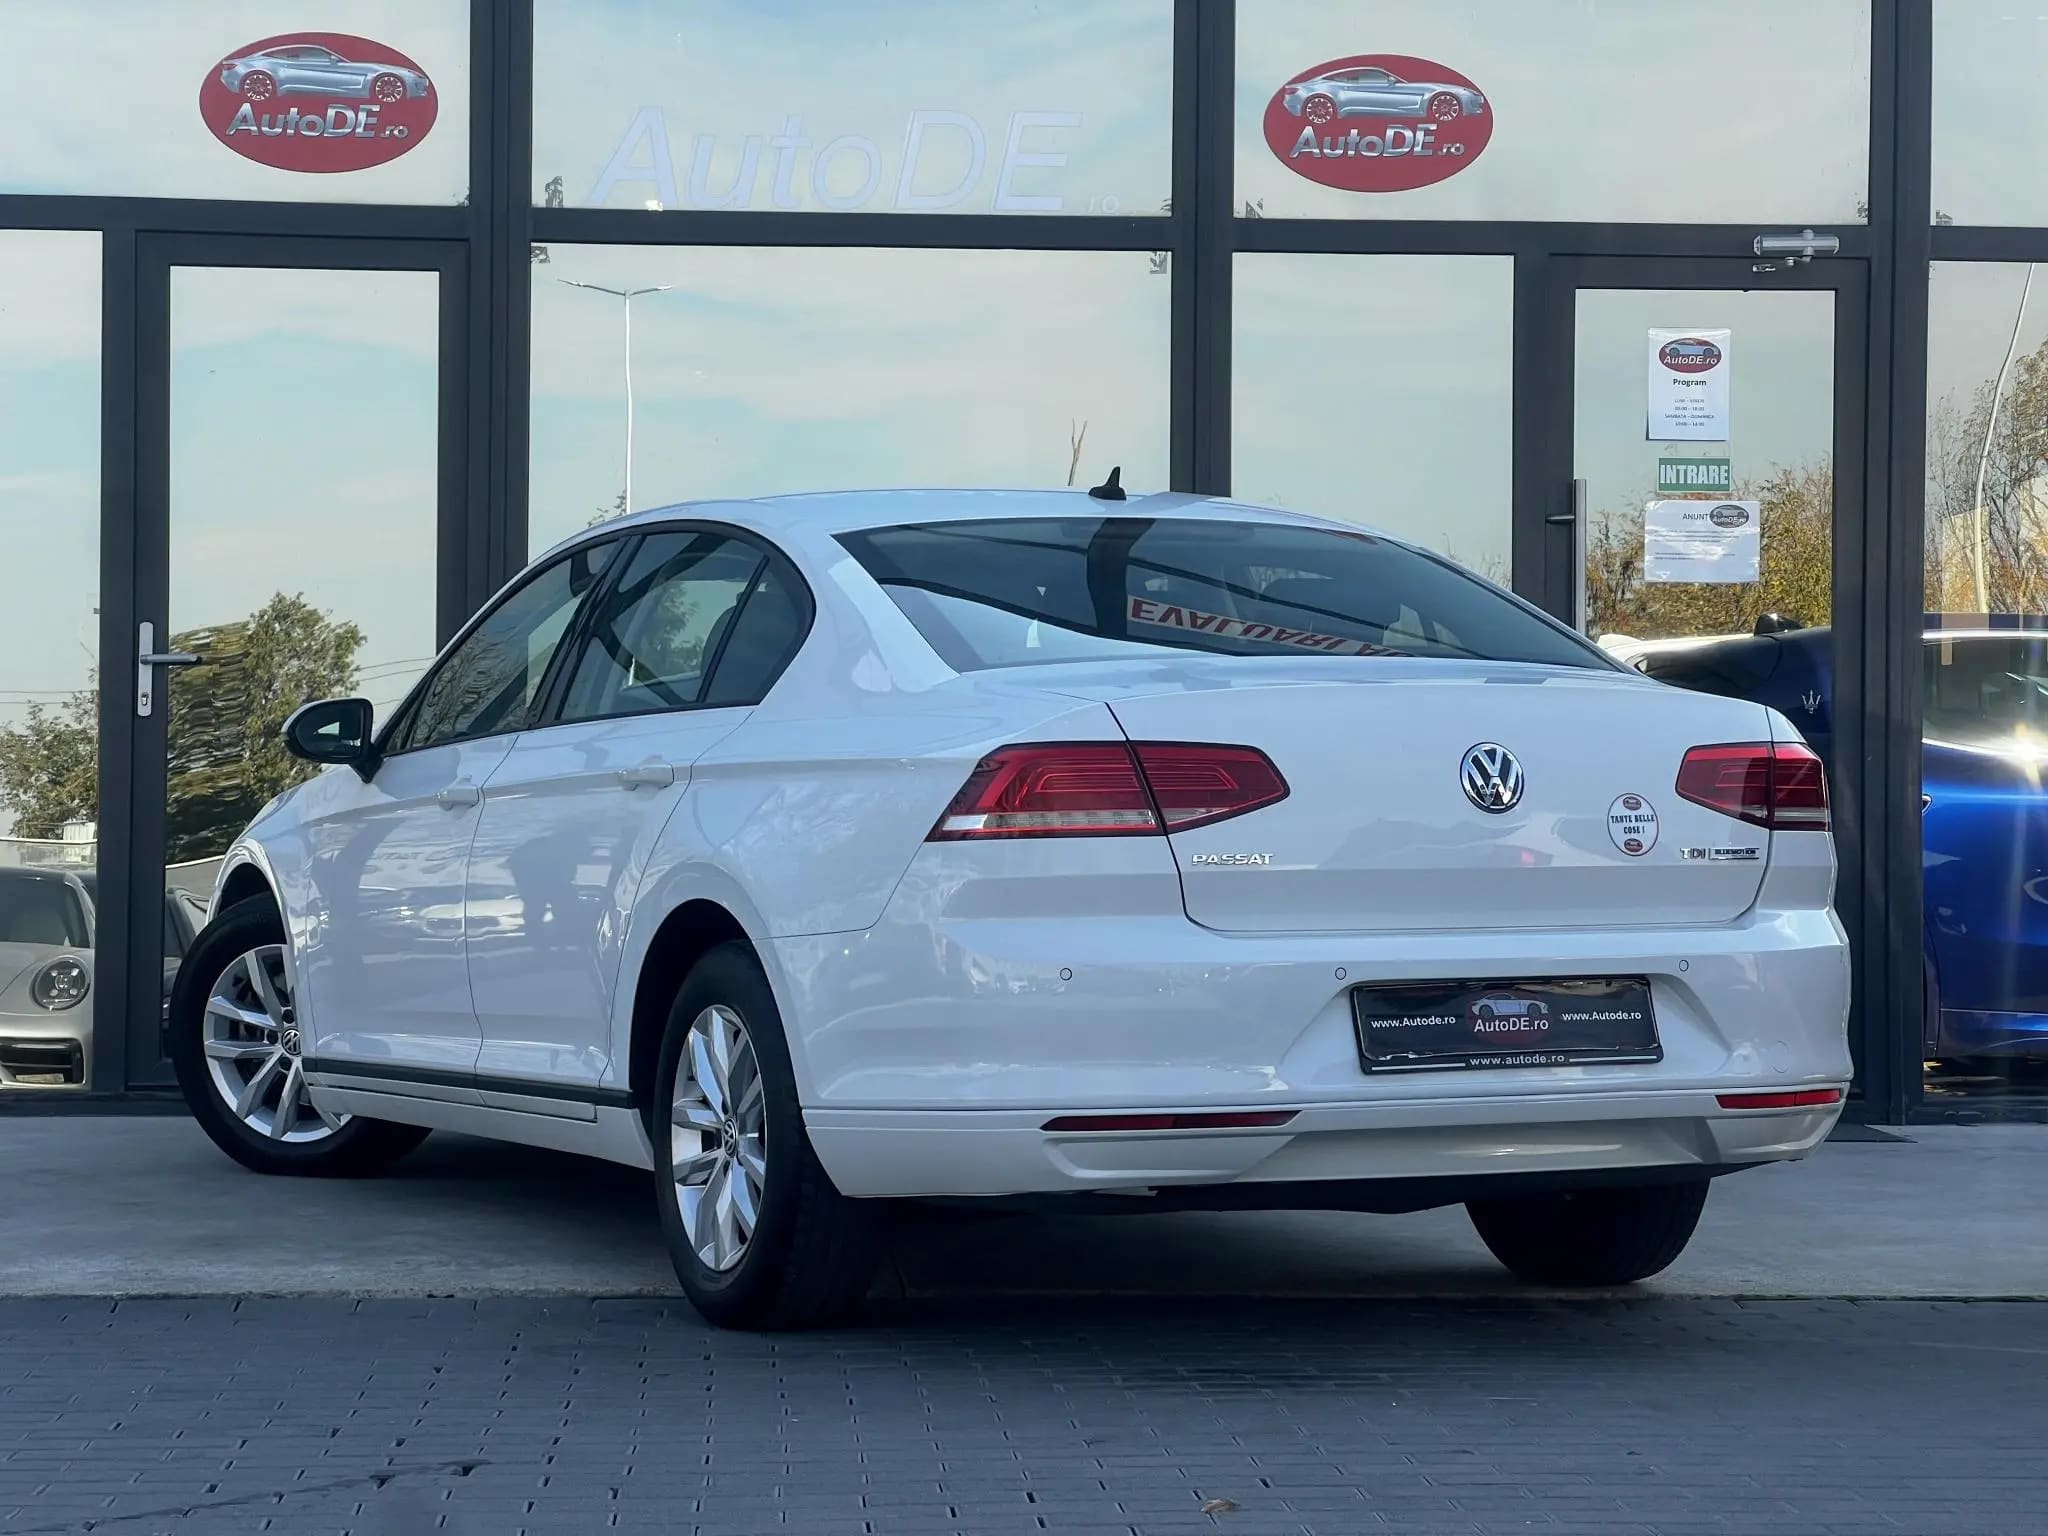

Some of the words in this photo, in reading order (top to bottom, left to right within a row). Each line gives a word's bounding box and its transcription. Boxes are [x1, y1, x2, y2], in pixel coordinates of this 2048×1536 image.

[1672, 378, 1707, 387] Program
[1659, 464, 1729, 485] INTRARE
[1634, 814, 1655, 823] BELLE
[1623, 825, 1641, 834] COSE
[1192, 853, 1273, 865] PASSAT
[1680, 848, 1706, 859] TDI
[1371, 1014, 1456, 1028] www.Autode.ro
[1561, 1010, 1642, 1022] www.Autode.ro
[1473, 1016, 1549, 1033] AutoDE.ro
[1469, 1053, 1565, 1066] www.autode.ro
